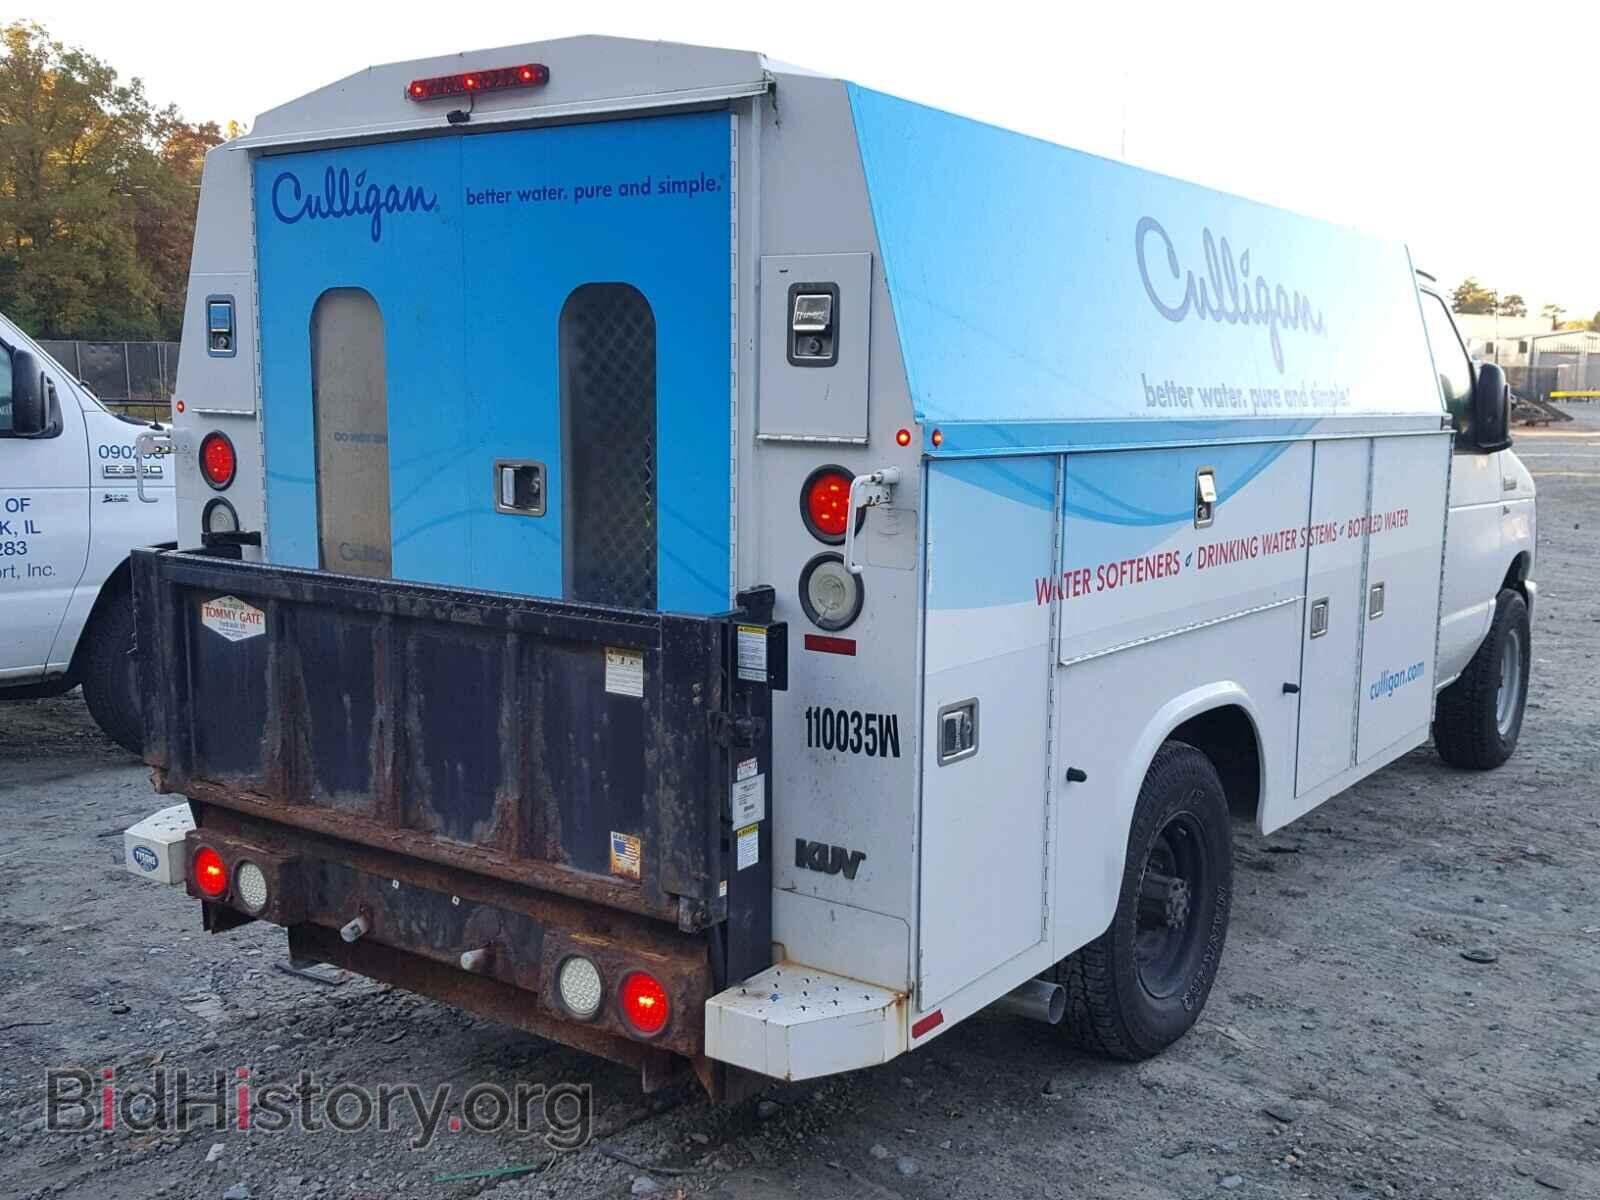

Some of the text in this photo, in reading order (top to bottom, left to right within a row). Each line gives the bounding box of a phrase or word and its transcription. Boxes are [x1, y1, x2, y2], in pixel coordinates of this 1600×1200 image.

[271, 165, 438, 243] Culligan
[466, 172, 722, 206] better water. pure and simple.
[1135, 216, 1325, 375] Culligan
[1141, 373, 1195, 408] better
[1249, 386, 1281, 416] pure
[1284, 380, 1308, 408] and
[5, 498, 31, 513] OF
[24, 519, 42, 534] IL
[28, 563, 56, 578] Inc.
[1096, 551, 1181, 592] SOFTENERS
[1197, 536, 1259, 570] DRINKING
[1262, 529, 1298, 556] WATER
[1384, 509, 1409, 531] WATER
[204, 606, 262, 625] TOMMY GATE
[805, 705, 901, 758] 110035W
[795, 838, 867, 881] KUV
